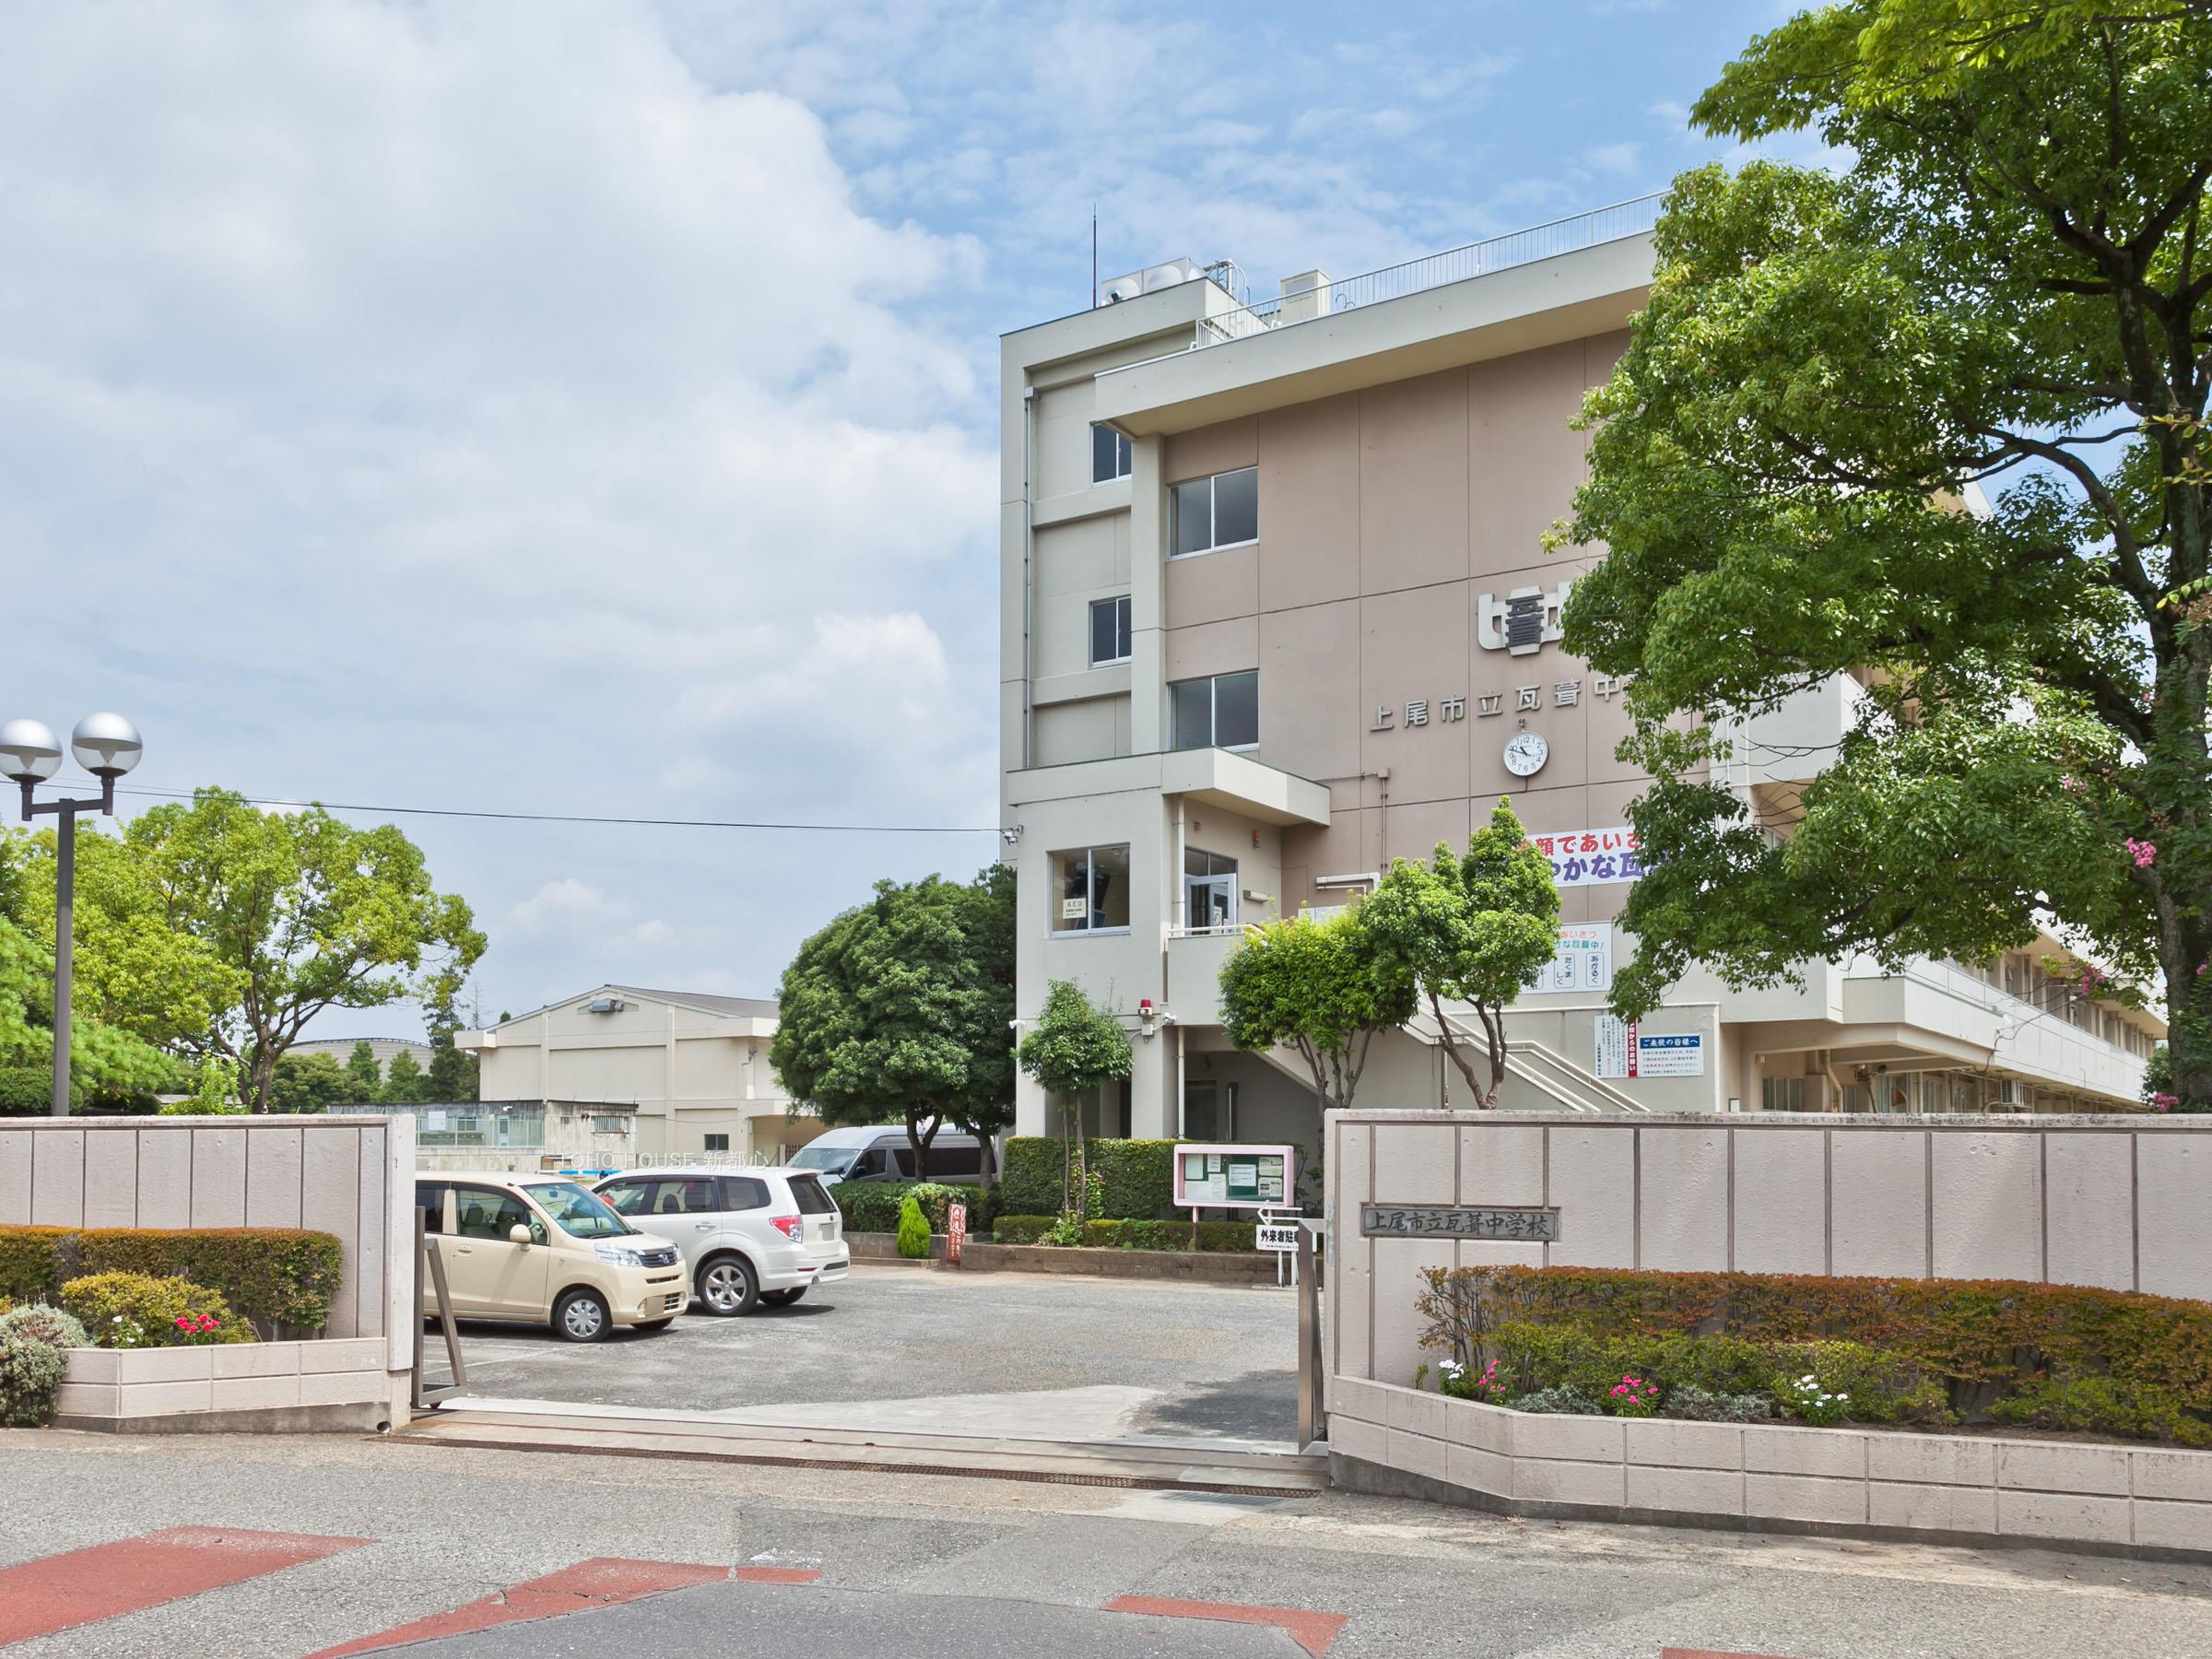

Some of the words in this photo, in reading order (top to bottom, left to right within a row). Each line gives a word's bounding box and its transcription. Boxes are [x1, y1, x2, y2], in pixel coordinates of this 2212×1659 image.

[1066, 900, 1083, 908] AED
[1368, 1210, 1552, 1238] 上尾市立瓦葺中学校
